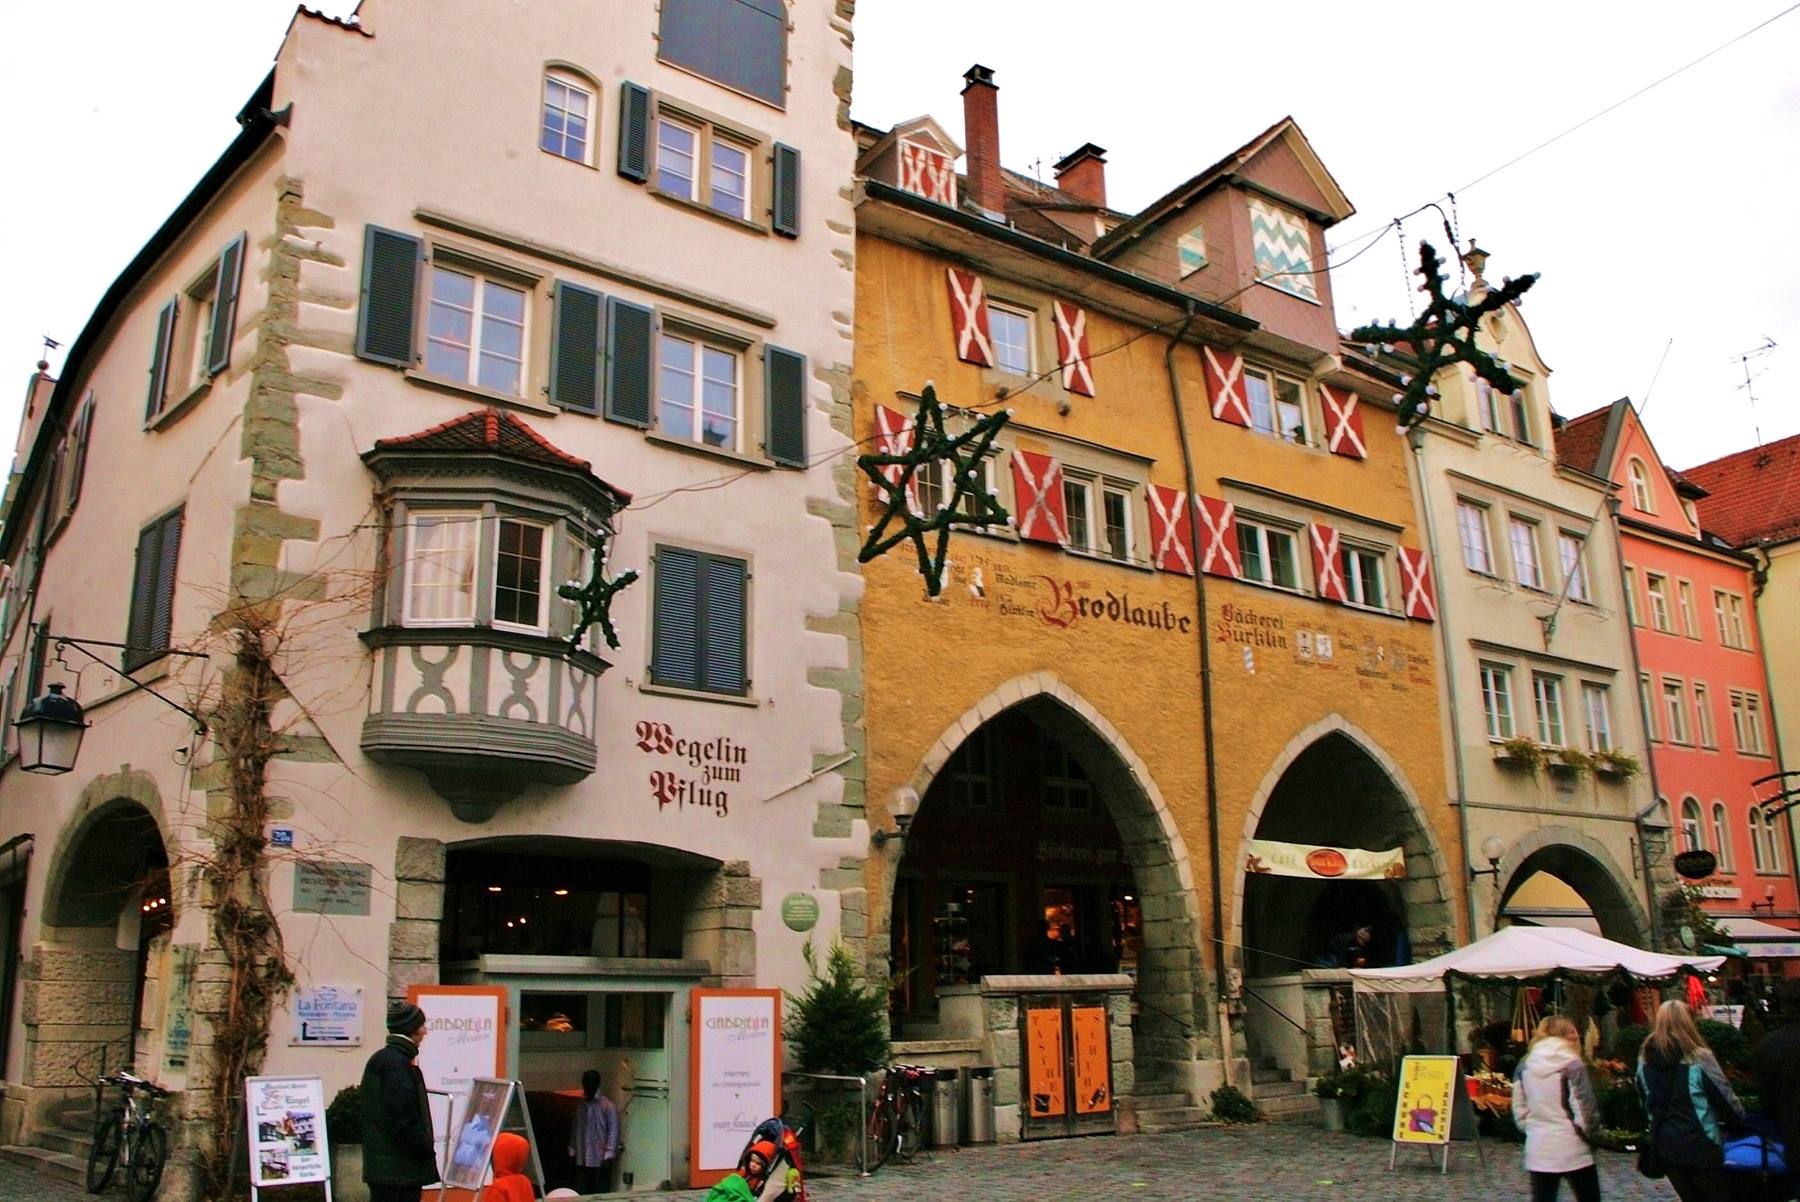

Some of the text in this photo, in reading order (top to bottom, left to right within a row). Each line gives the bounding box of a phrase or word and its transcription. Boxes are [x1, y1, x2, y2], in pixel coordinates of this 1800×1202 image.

[1030, 574, 1191, 633] Brodlaube
[1222, 603, 1284, 629] Bäckerei
[636, 720, 747, 768] Wegelin
[702, 765, 740, 785] zum
[650, 770, 728, 818] Pflug
[298, 998, 358, 1012] La Fontana
[705, 1015, 769, 1031] GABRIELLA
